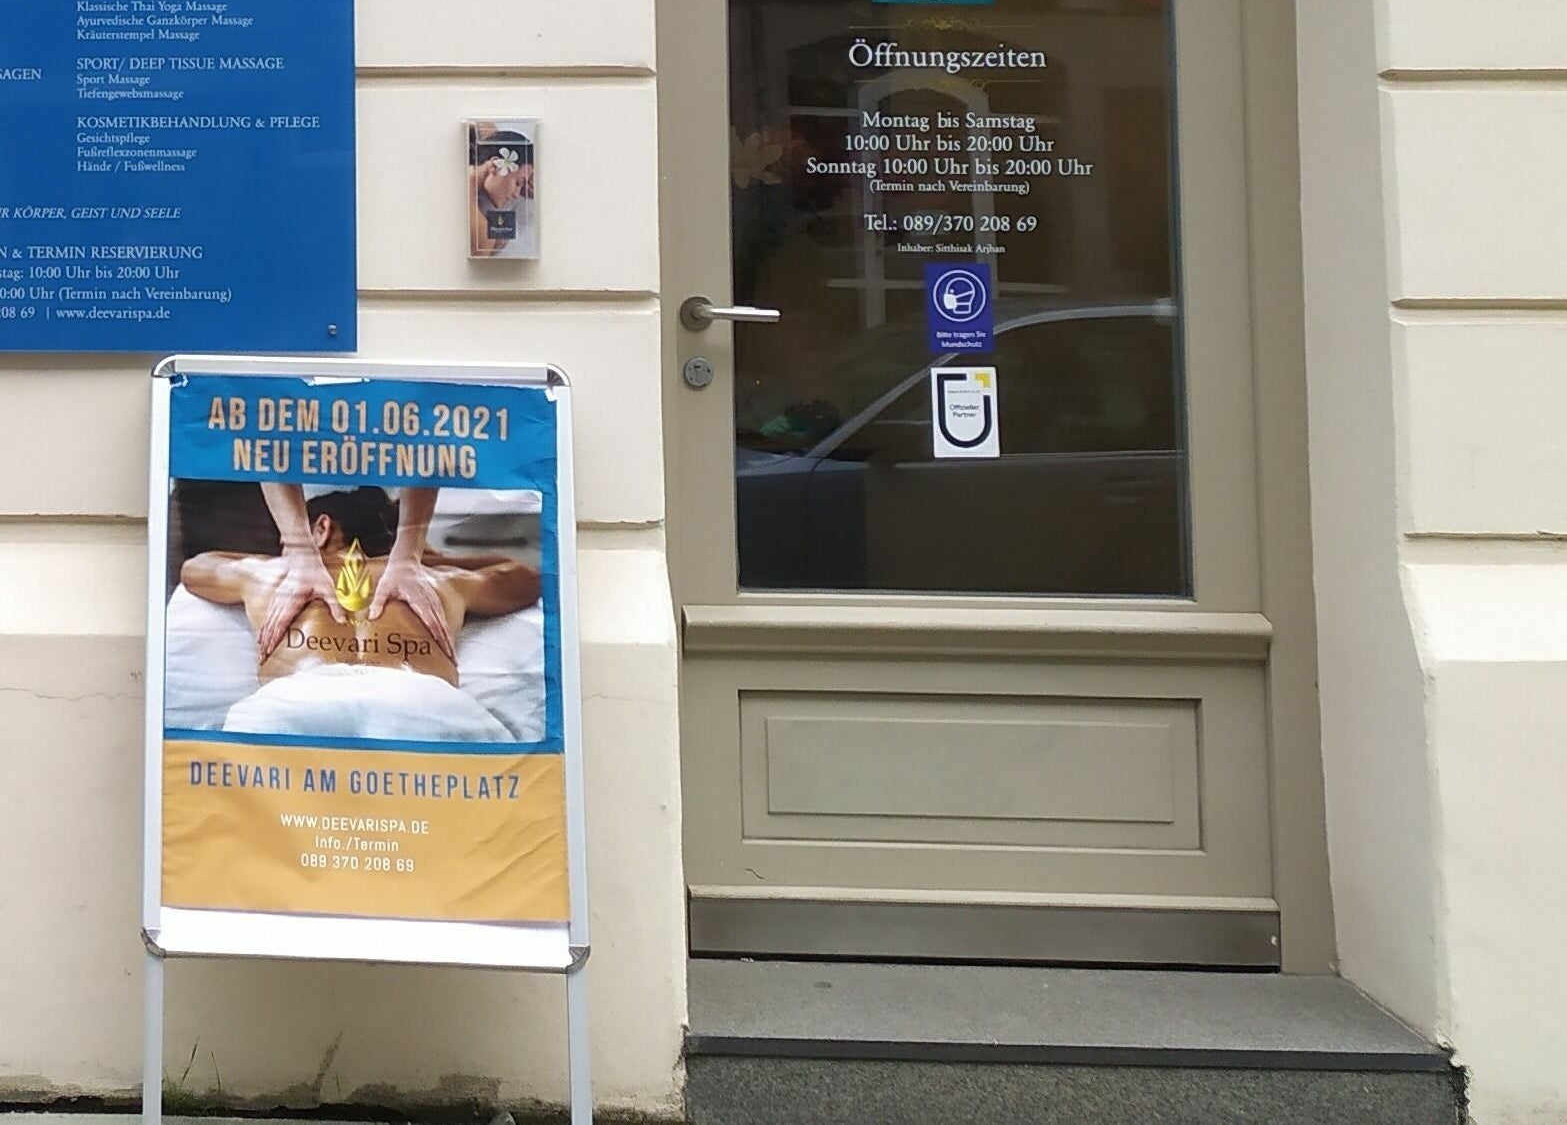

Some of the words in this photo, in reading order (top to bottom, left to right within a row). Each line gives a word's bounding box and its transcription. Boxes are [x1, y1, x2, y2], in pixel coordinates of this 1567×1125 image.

[77, 1, 128, 11] Klassische
[132, 1, 155, 11] Thai
[159, 1, 181, 13] Yoga
[186, 2, 227, 13] Massage
[77, 15, 144, 27] Ayurvedische
[147, 15, 207, 27] Ganzkörper
[212, 16, 253, 27] Massage
[77, 30, 154, 41] Kräuterstempel
[159, 30, 199, 41] Massage
[130, 57, 166, 69] DEEP
[169, 58, 214, 69] TISSUE
[220, 58, 284, 69] MASSAGE
[848, 38, 1047, 73] Öffnungszeiten
[77, 75, 104, 86] Sport
[109, 75, 150, 86] Massage
[78, 117, 250, 128] KOSMETIKBEHANDLUNG
[254, 118, 265, 129] &
[270, 117, 320, 128] PFLEGE
[862, 112, 930, 131] Montag
[937, 112, 960, 128] bis
[965, 112, 1035, 133] Samstag
[845, 135, 890, 151] 10:00
[894, 135, 931, 151] Uhr
[937, 135, 960, 151] bis
[966, 136, 1013, 152] 20:00
[1018, 136, 1055, 152] Uhr
[806, 157, 877, 177] Sonntag
[882, 159, 927, 174] 10:00
[933, 159, 968, 175] Uhr
[975, 159, 999, 175] bis
[1004, 159, 1051, 175] 20:00
[1056, 159, 1093, 176] Uhr
[869, 180, 913, 194] (Termin
[917, 180, 945, 192] nach
[948, 180, 1029, 195] Vereinbarung)
[14, 206, 66, 219] KÖRPER,
[71, 208, 107, 218] GEIST
[111, 208, 141, 218] UND
[143, 208, 181, 219] SEELE
[863, 214, 897, 231] Tel.:
[903, 215, 974, 235] 089/370
[979, 216, 1010, 232] 208
[1016, 216, 1037, 232] 69
[12, 249, 22, 258] &
[27, 246, 85, 258] TERMIN
[92, 245, 202, 258] RESERVIERUNG
[30, 267, 62, 278] 10:00
[66, 266, 90, 278] Uhr
[96, 266, 112, 278] bis
[117, 267, 151, 278] 20:00
[155, 266, 179, 278] Uhr
[30, 287, 54, 299] Uhr
[59, 287, 106, 301] (Termin
[112, 287, 140, 299] nach
[145, 287, 231, 302] Vereinbarung)
[21, 307, 35, 318] 69
[56, 306, 170, 322] www.deevarispa.de
[208, 397, 247, 431] AB
[258, 398, 320, 433] DEM
[332, 400, 509, 441] 01.06.2021
[233, 438, 290, 472] NEU
[302, 435, 478, 478] ERÖFFNUNG
[286, 627, 380, 654] Deevari
[386, 633, 432, 657] Spa
[190, 761, 290, 791] DEEVARI
[303, 768, 337, 793] AM
[350, 770, 521, 799] GOETHEPLATZ
[281, 814, 429, 834] WWW.DEEVARISPA.DE
[301, 853, 327, 867] 089
[333, 855, 359, 869] 370
[365, 857, 390, 871] 208
[397, 859, 414, 872] 69
